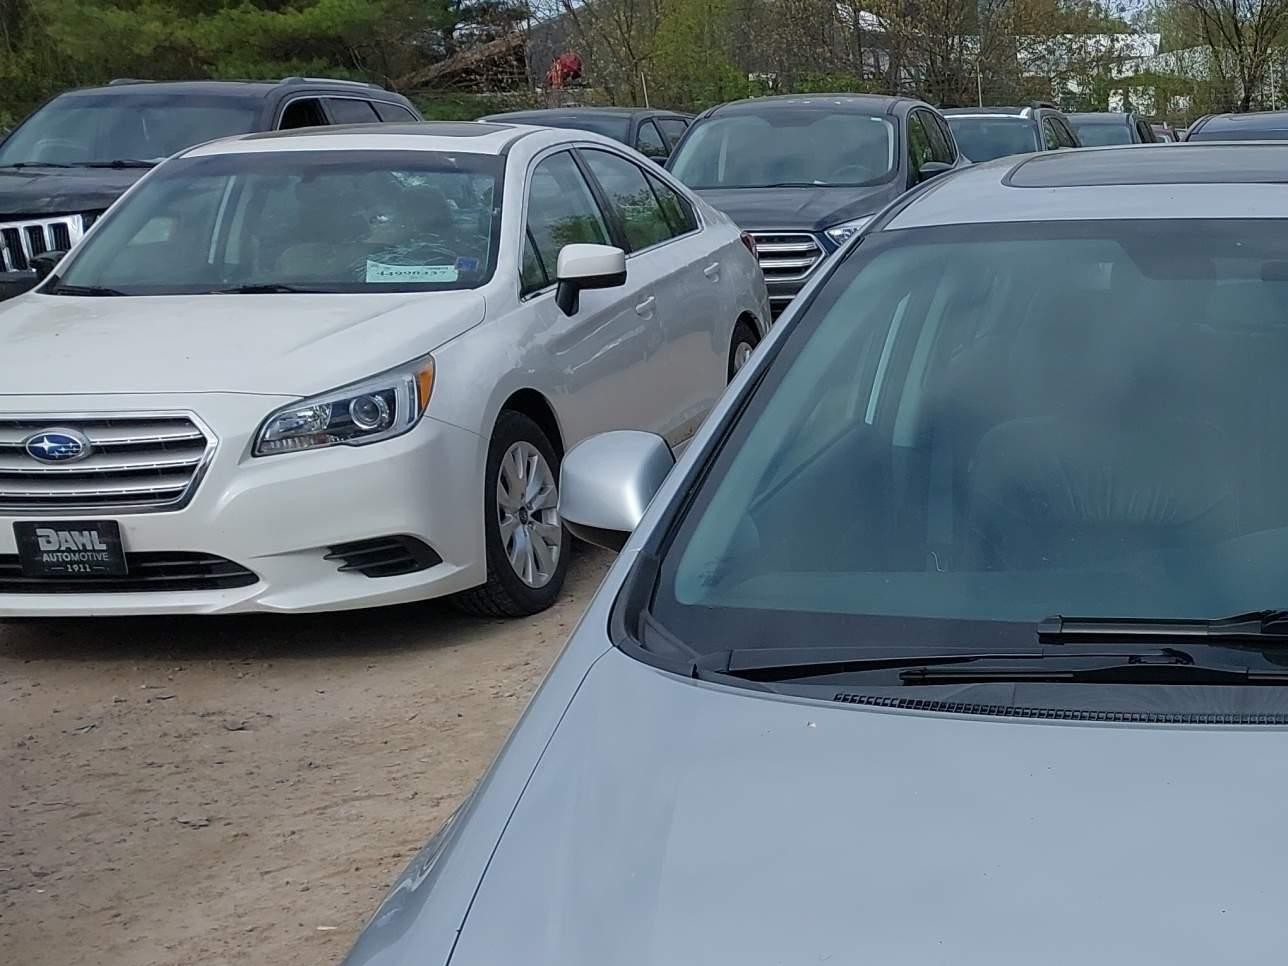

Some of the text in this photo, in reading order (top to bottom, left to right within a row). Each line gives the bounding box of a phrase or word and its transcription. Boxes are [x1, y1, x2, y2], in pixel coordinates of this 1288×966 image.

[35, 528, 107, 551] DAHL
[42, 552, 109, 562] AUTOMOTIVE
[66, 564, 92, 572] 1911
